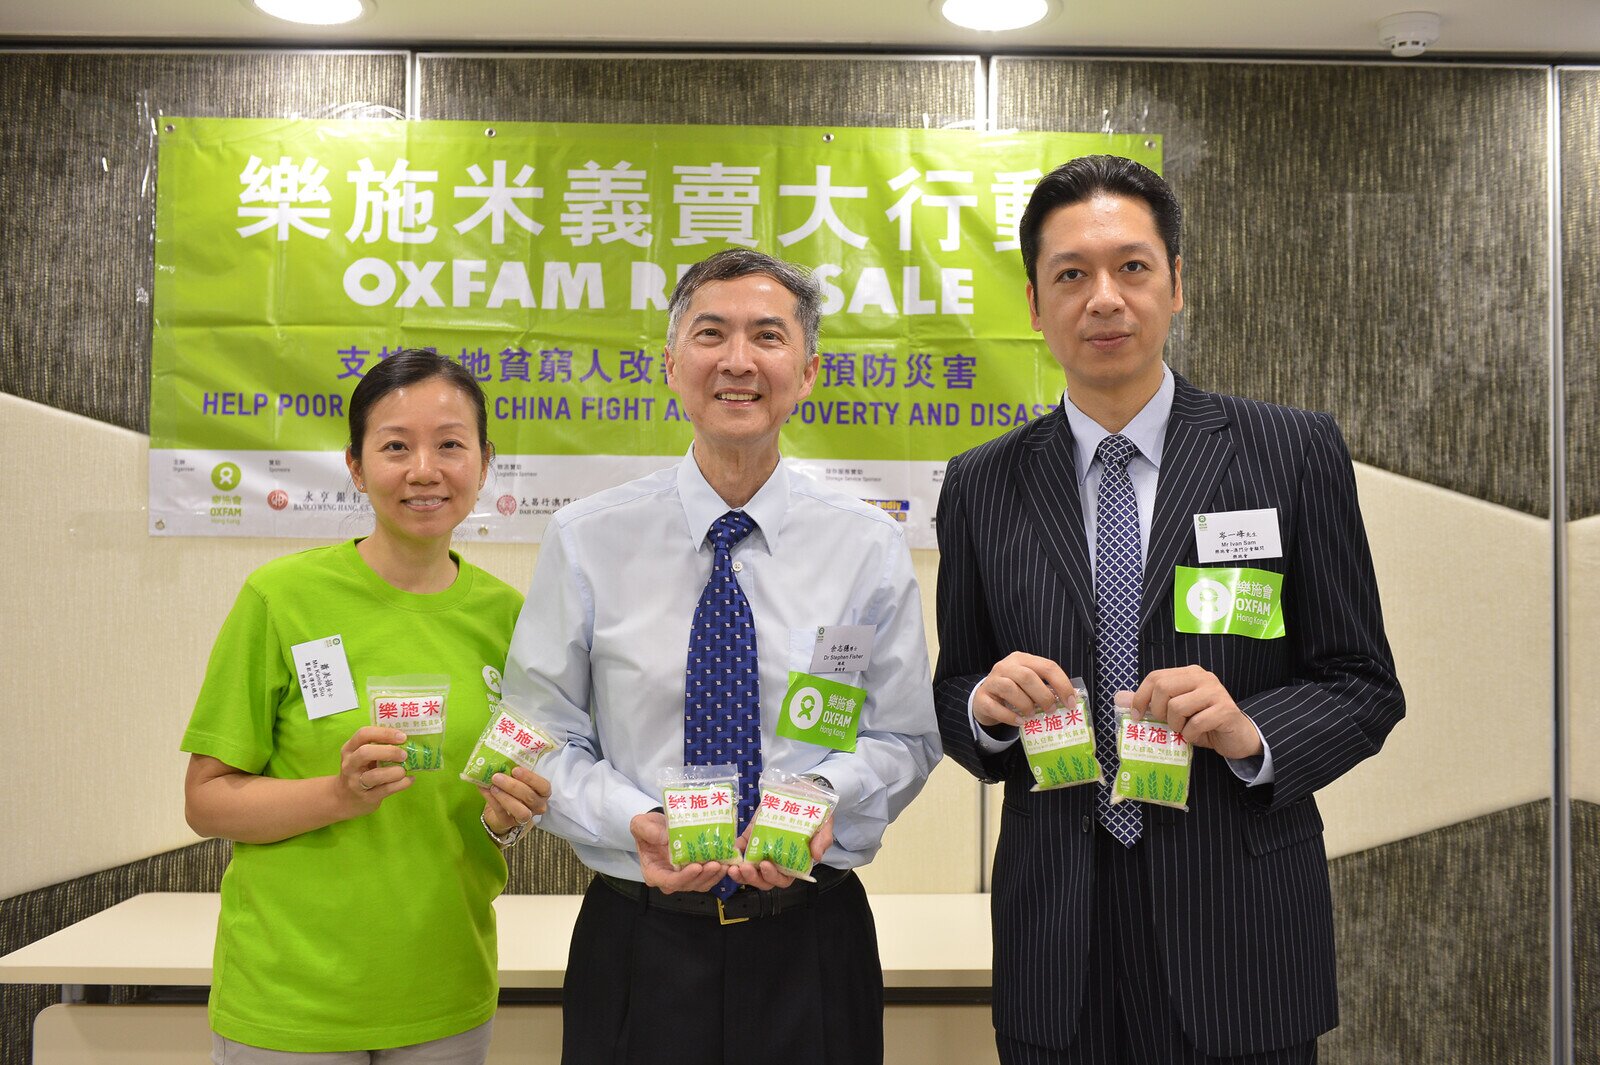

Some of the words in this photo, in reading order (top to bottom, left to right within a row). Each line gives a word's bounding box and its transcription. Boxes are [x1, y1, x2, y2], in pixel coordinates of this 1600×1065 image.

[343, 257, 603, 310] OXFAM
[814, 264, 974, 315] SALE
[822, 352, 976, 390] 預防災害
[202, 392, 268, 417] HELP
[278, 394, 345, 417] POOR
[495, 396, 572, 420] CHINA
[581, 397, 656, 421] FIGHT
[909, 402, 960, 426] AND
[210, 508, 242, 517] OXFAM
[1237, 580, 1274, 600] 樂施會
[1236, 598, 1271, 616] OXFAM
[1237, 613, 1253, 624] Hong
[1253, 617, 1269, 627] Kong
[378, 700, 440, 720] 樂施米
[827, 694, 857, 714] 樂施會
[822, 711, 852, 728] OXFAM
[1024, 709, 1083, 736] 樂施米
[496, 716, 546, 754] 樂施米
[820, 725, 832, 736] Hong
[833, 728, 845, 739] Kong
[1126, 724, 1187, 746] 樂施米
[668, 791, 730, 810] 樂施米
[761, 793, 822, 820] 樂施米
